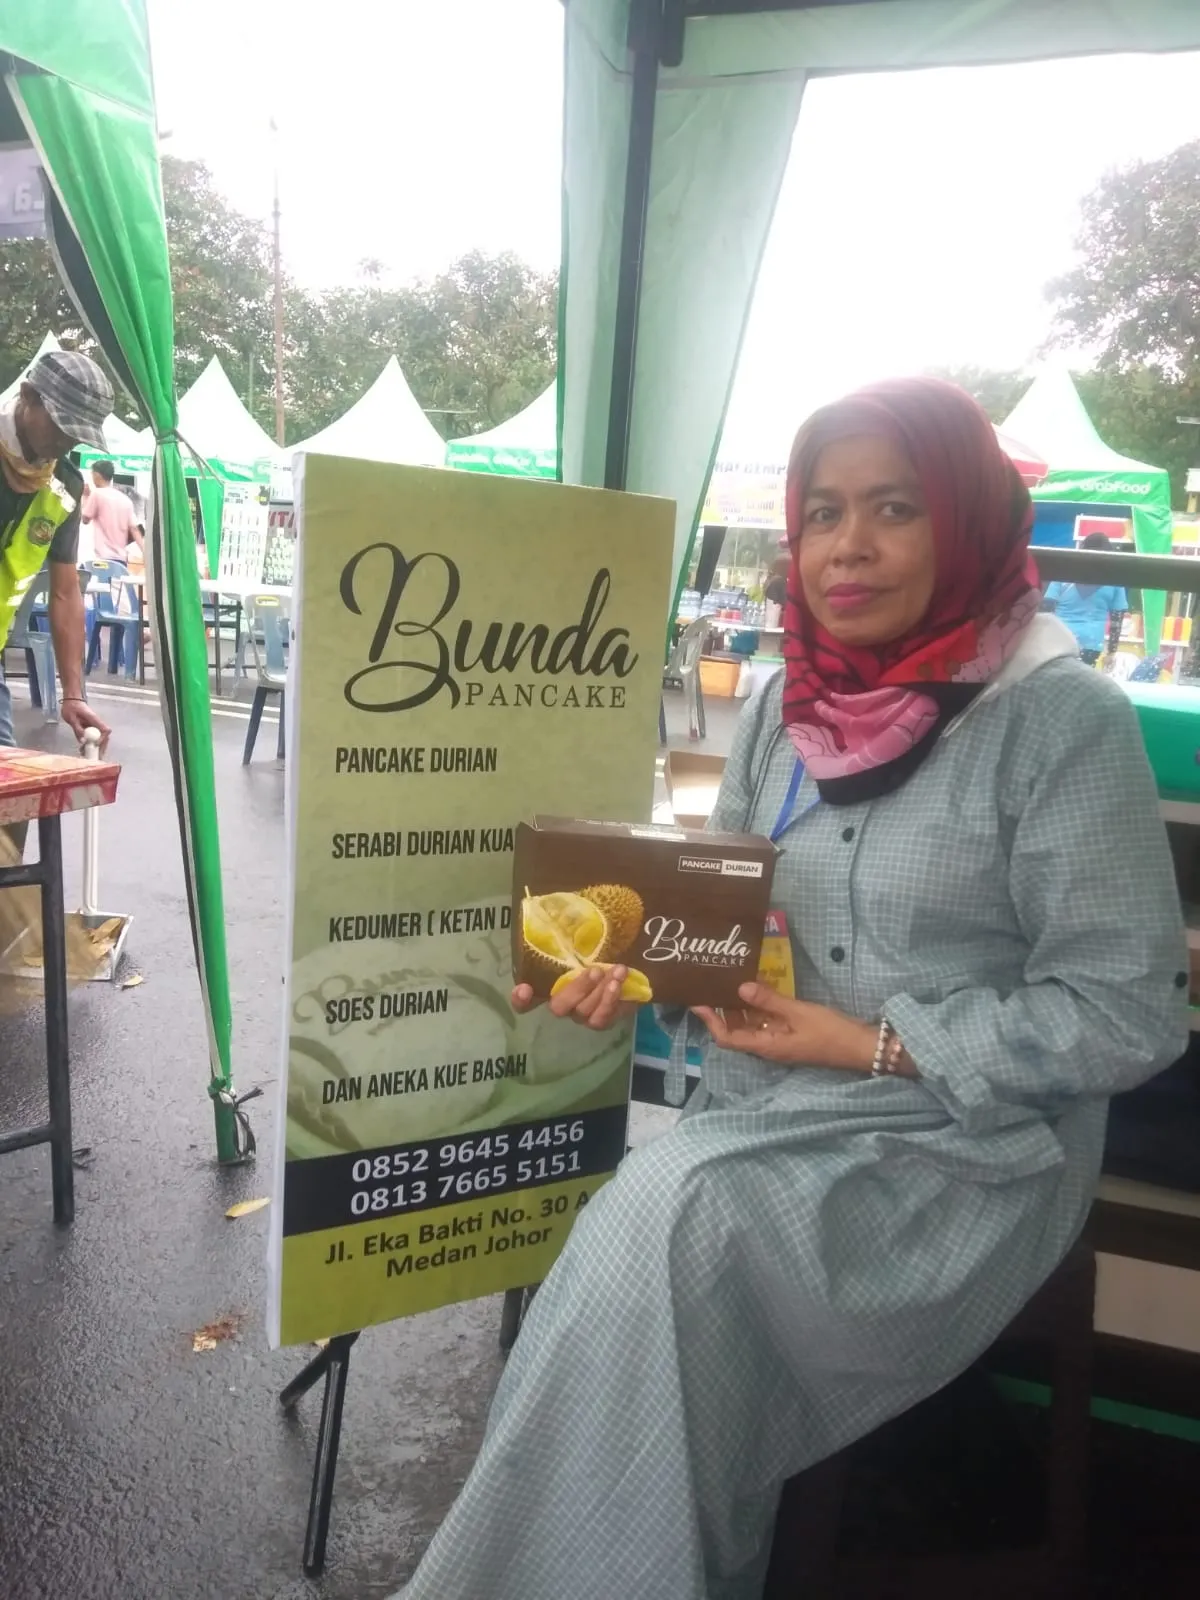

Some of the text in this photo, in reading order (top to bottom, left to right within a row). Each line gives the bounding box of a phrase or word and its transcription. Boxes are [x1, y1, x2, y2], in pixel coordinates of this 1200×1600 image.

[339, 542, 639, 713] Bunda
[465, 682, 626, 709] PANCAKE
[335, 747, 498, 774] PANCAKE DURIAN
[331, 830, 402, 860] SERABI
[406, 829, 476, 856] DURIAN
[681, 859, 759, 873] PANCAKE DURIAN
[328, 912, 422, 943] KEDUMER
[427, 909, 436, 937] (
[439, 906, 496, 935] KETAN
[642, 915, 752, 962] Bunda
[683, 952, 745, 967] PANCAKE
[325, 988, 449, 1025] SOES DURIAN
[322, 1053, 528, 1105] DAN ANEKA KUE BASAH
[351, 1120, 585, 1183] 0852 9645 4456
[350, 1150, 582, 1216] 0813 7665 5151
[324, 1240, 353, 1265] Jl.
[362, 1231, 410, 1257] Eka
[418, 1212, 484, 1245] Bakti
[490, 1206, 533, 1229] No.
[540, 1194, 569, 1218] 30
[385, 1225, 553, 1278] Medan Johor
